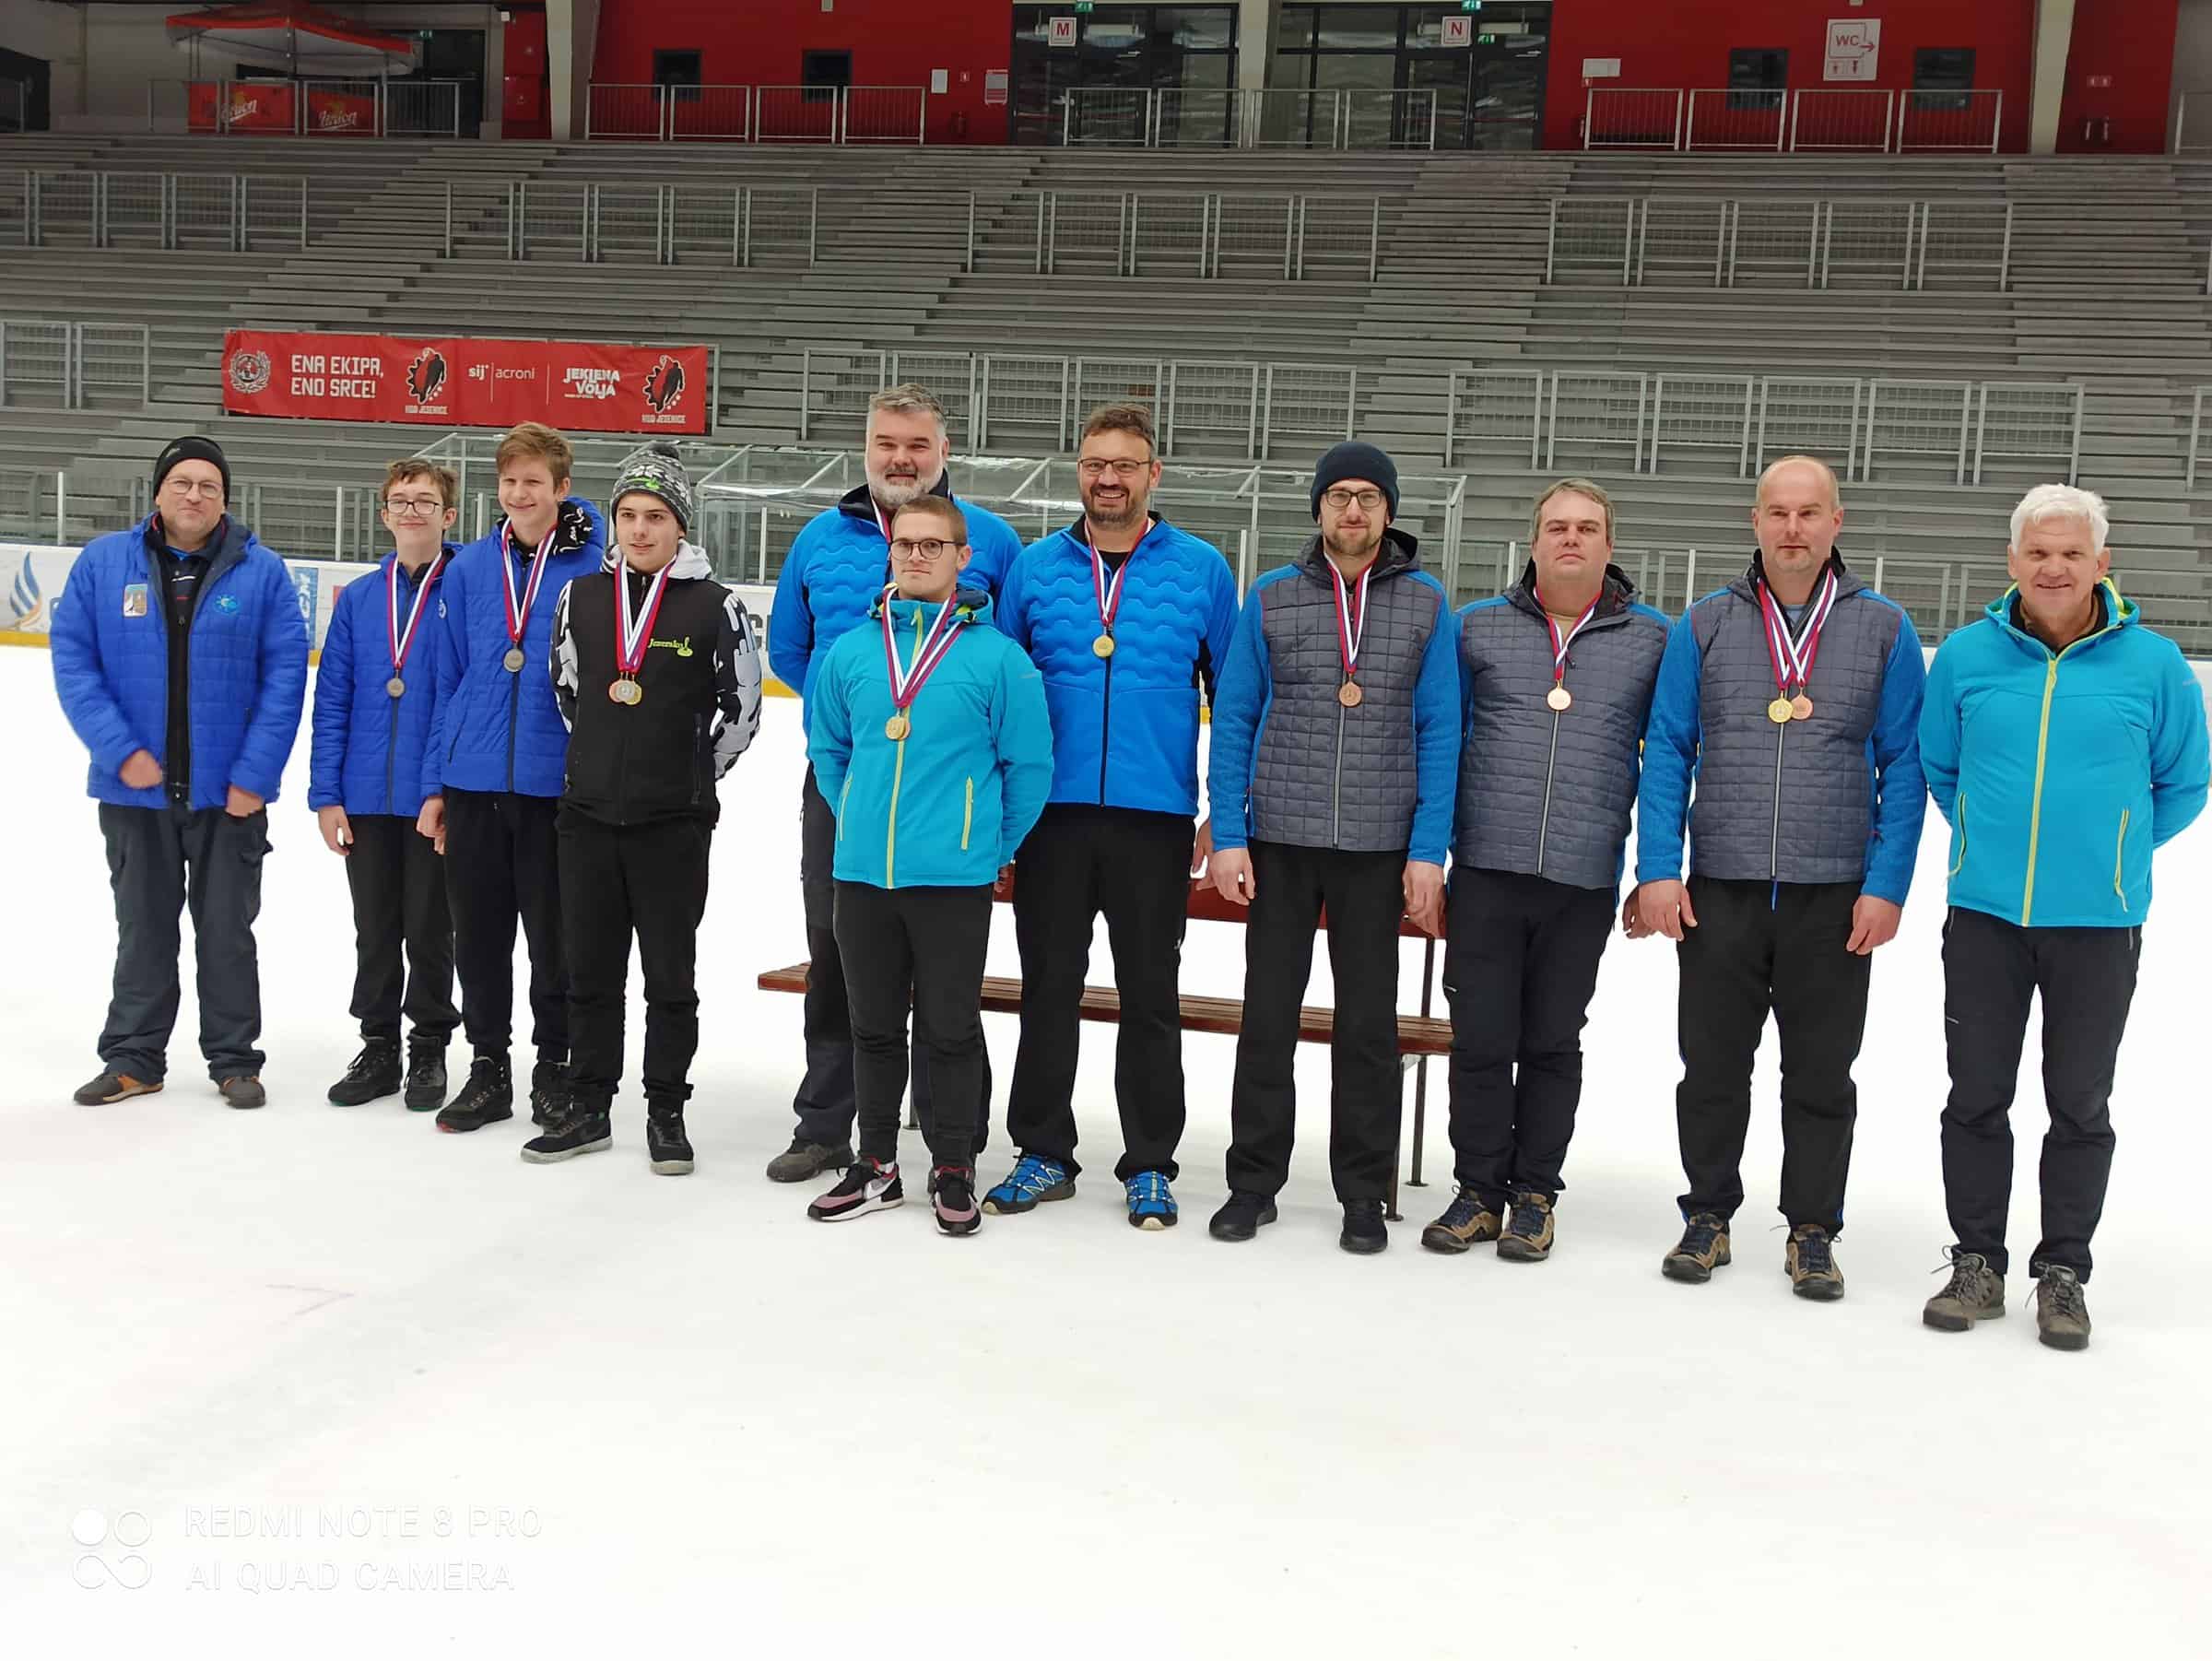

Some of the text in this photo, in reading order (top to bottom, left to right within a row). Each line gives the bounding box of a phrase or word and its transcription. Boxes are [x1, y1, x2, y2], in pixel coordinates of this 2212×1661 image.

[1055, 22, 1070, 37] M
[1451, 21, 1463, 36] N
[1835, 34, 1859, 47] WC
[291, 354, 384, 379] ENA EKIPA,
[495, 368, 535, 380] acroni
[290, 377, 376, 399] ENO SRCE!
[575, 381, 617, 399] VOLJA
